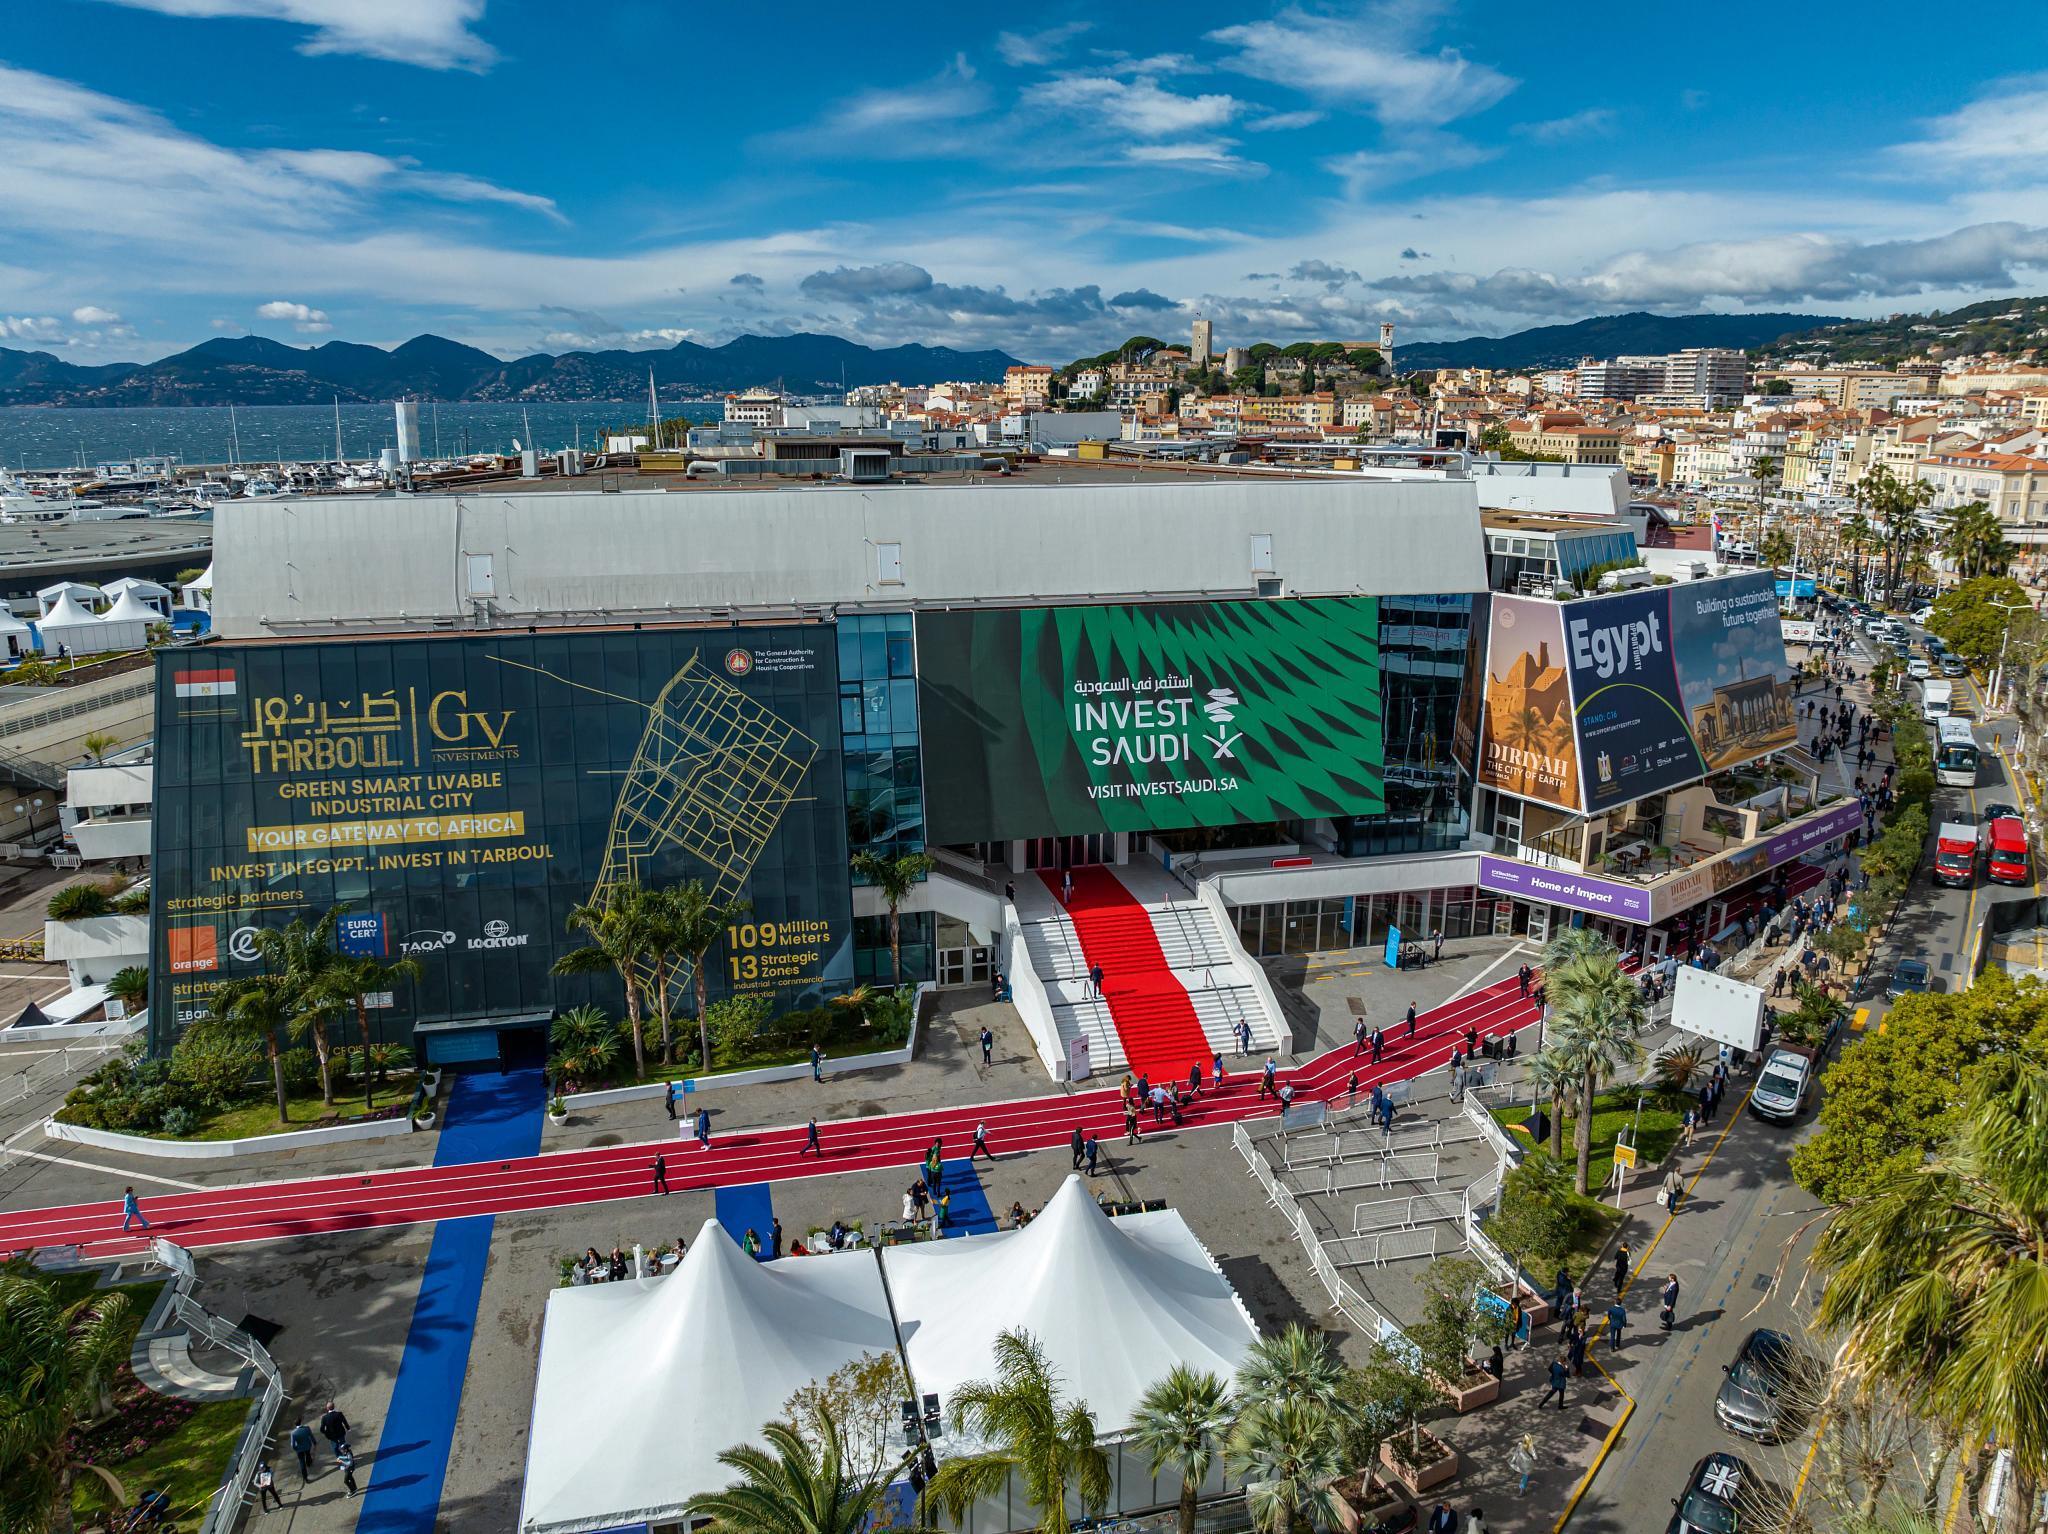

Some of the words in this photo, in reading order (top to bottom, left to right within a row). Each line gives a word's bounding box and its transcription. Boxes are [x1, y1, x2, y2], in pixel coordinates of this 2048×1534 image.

[1696, 598, 1727, 614] Building
[1728, 598, 1734, 608] a
[1735, 588, 1775, 607] sustainable
[1722, 614, 1744, 627] future
[1745, 607, 1777, 624] together.
[1569, 610, 1663, 679] Egypt
[1629, 622, 1642, 670] OPPORTUNITY
[1074, 677, 1130, 697] السعودية
[1131, 677, 1152, 694] في
[1154, 674, 1193, 693] استثمر
[1074, 698, 1193, 732] INVEST
[241, 734, 403, 774] TARBOUL
[432, 750, 520, 763] INVESTMENTS
[1092, 733, 1190, 766] SAUDI
[1487, 742, 1568, 778] DIRIYAH
[279, 778, 347, 800] GREEN
[351, 775, 423, 796] SMART
[427, 771, 502, 792] LIVABLE
[1487, 760, 1503, 772] THE
[1504, 765, 1524, 777] CITY
[1525, 770, 1537, 780] OF
[1538, 774, 1568, 788] EARTH
[1087, 784, 1123, 799] VISIT
[1126, 777, 1239, 797] INVESTSAUDI.SA
[310, 797, 426, 817] INDUSTRIAL
[429, 793, 474, 810] CITY
[252, 828, 307, 847] YOUR
[312, 823, 410, 844] GATEWAY
[414, 822, 442, 838] TO
[446, 817, 517, 836] AFRICA
[1802, 831, 1816, 841] Home
[1815, 826, 1820, 835] of
[1820, 822, 1834, 834] Impact
[210, 862, 276, 882] INVEST
[281, 861, 302, 877] IN
[305, 857, 375, 875] EGYPT..
[379, 851, 443, 871] INVEST
[447, 850, 467, 865] IN
[471, 844, 554, 864] TARBOUL
[1531, 877, 1561, 892] Home
[1563, 885, 1575, 894] of
[1577, 887, 1613, 903] Impact
[1671, 874, 1701, 896] DIRIYAH
[167, 893, 236, 911] strategic
[239, 887, 304, 906] partners
[347, 920, 377, 930] EURO
[350, 929, 378, 938] CERT
[728, 922, 777, 950] 109
[779, 920, 829, 934] Million
[399, 940, 446, 952] TAQA
[467, 934, 528, 949] LOCKTON
[780, 932, 831, 946] Meters
[173, 959, 213, 970] orange
[730, 955, 759, 980] 13
[761, 951, 819, 965] Strategic
[762, 966, 800, 978] Zones
[733, 979, 771, 990] industrial
